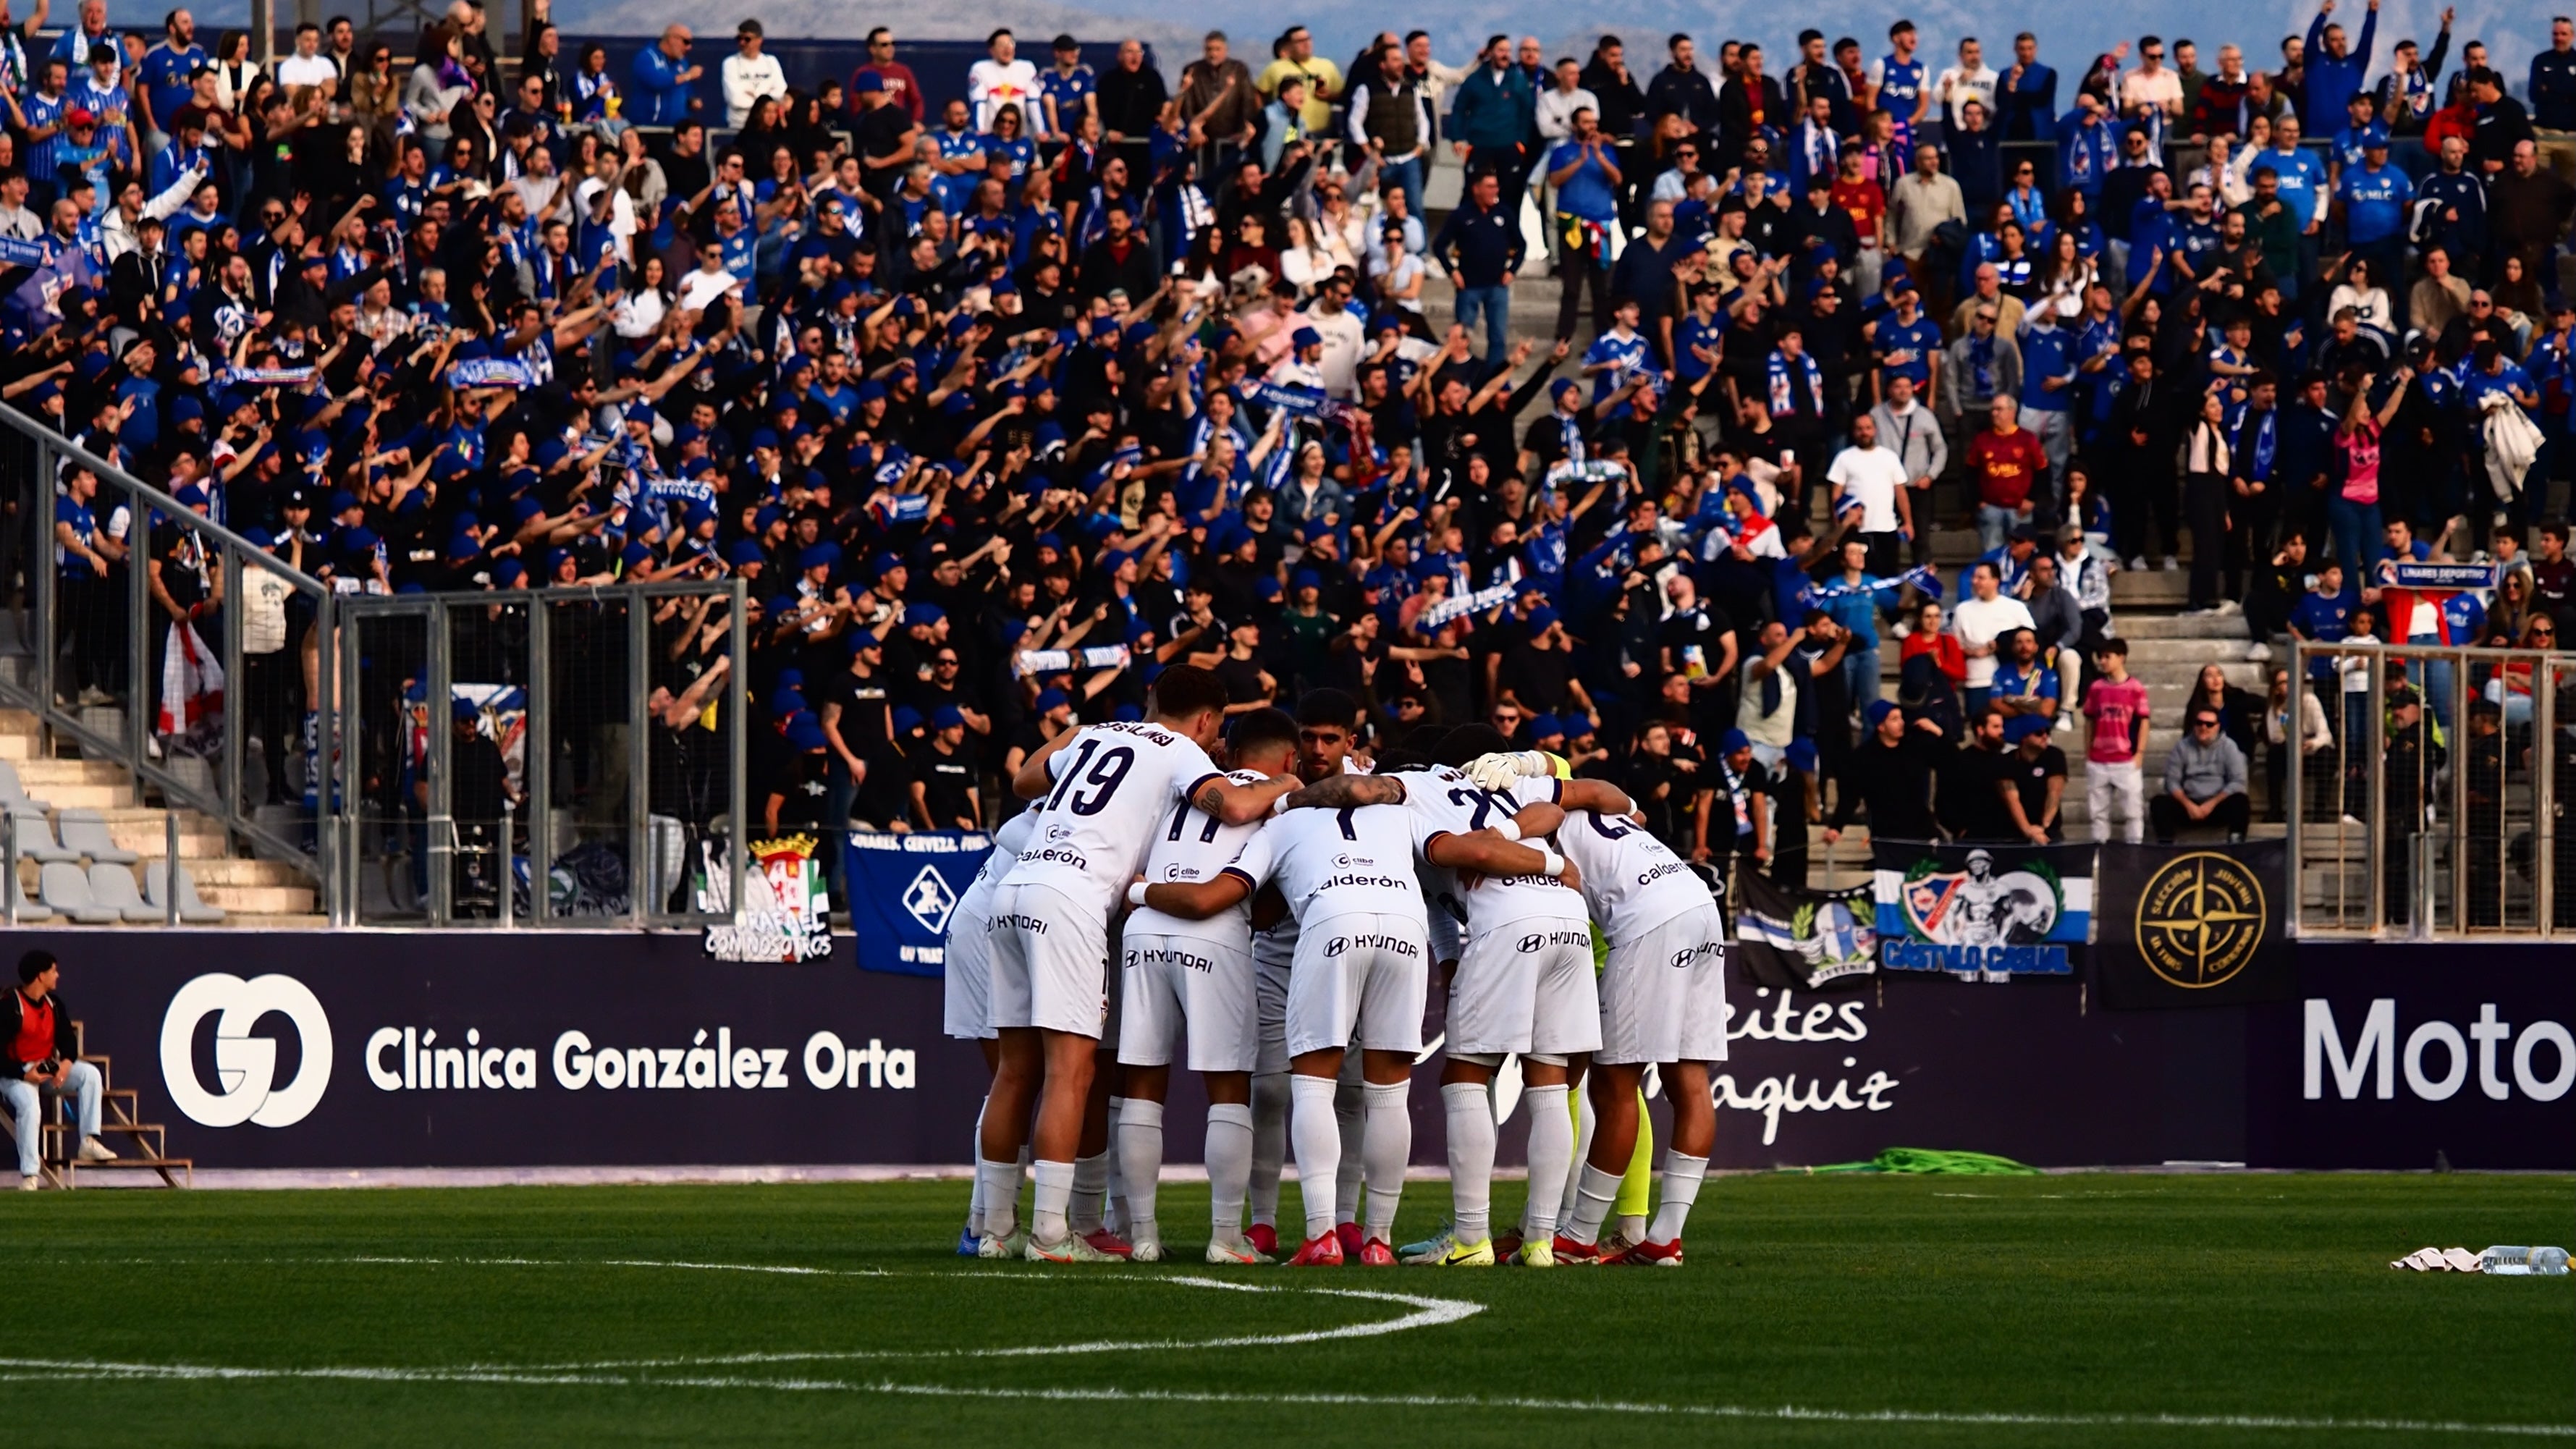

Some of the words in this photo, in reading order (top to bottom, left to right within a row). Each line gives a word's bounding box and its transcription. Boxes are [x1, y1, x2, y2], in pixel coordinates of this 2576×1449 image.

[1047, 738, 1135, 816] 19
[366, 1026, 536, 1090] Clínica
[552, 1026, 788, 1091] González
[803, 1030, 916, 1091] Orta
